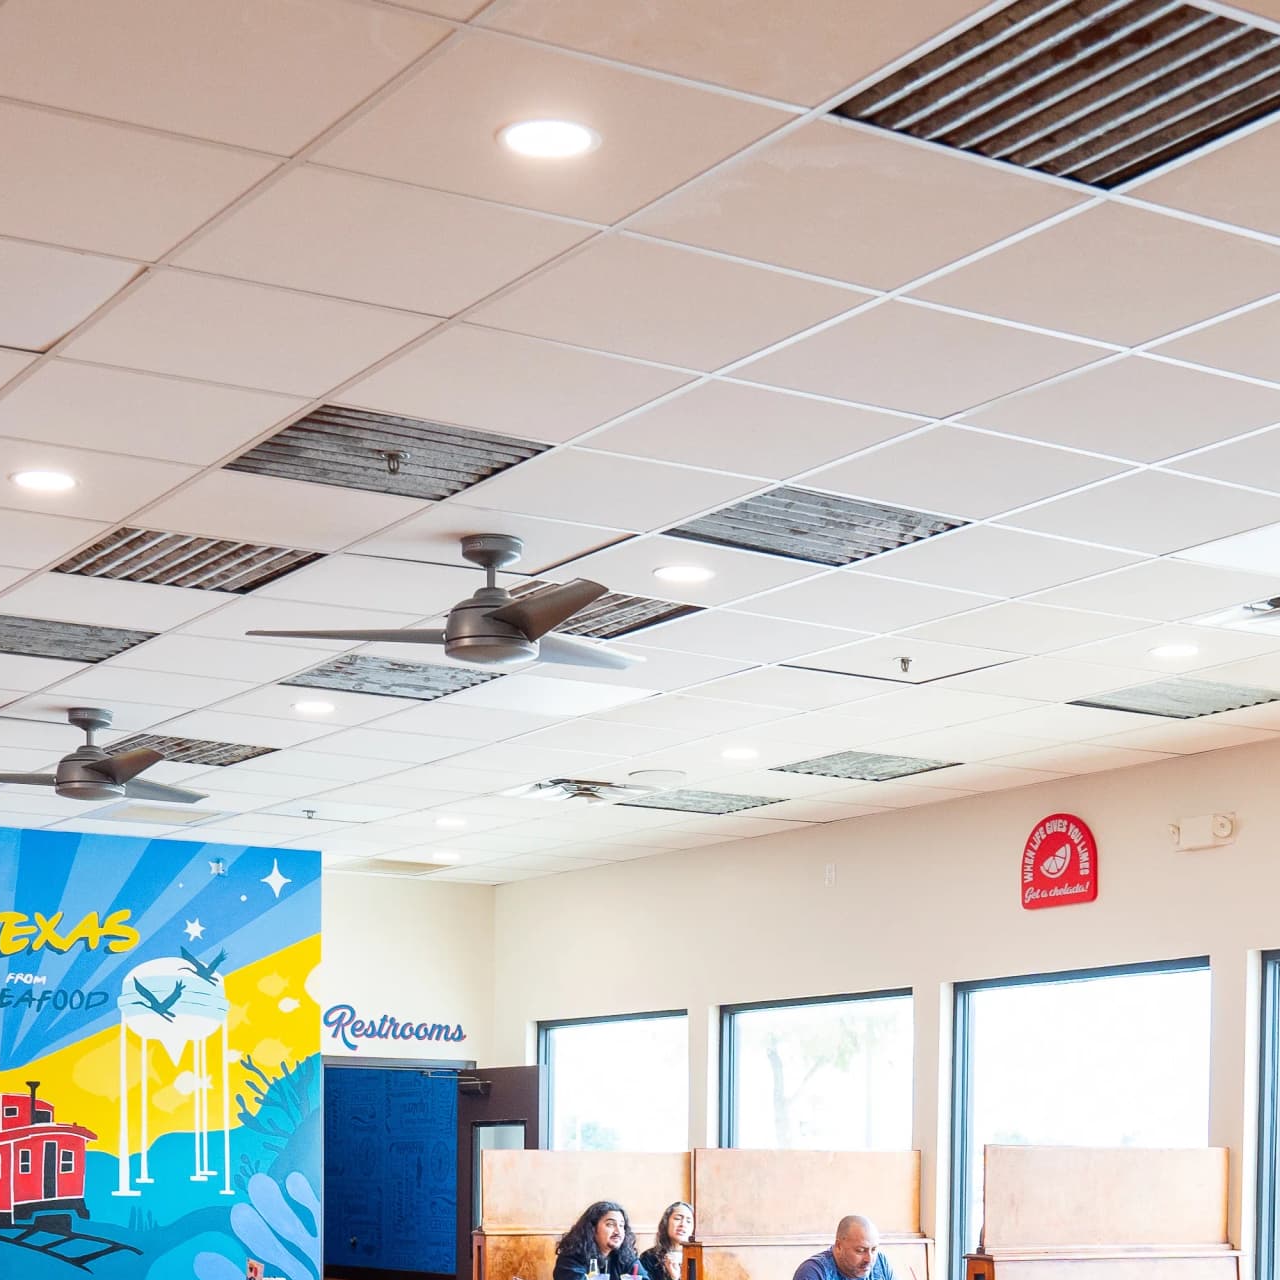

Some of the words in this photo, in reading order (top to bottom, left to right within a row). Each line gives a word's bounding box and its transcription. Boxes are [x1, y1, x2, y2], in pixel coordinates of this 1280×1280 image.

[1024, 850, 1036, 883] WHEN
[1031, 828, 1046, 850] LIFE
[1045, 819, 1068, 834] GIVES
[1068, 823, 1083, 843] YOU
[1025, 886, 1039, 903] Get
[5, 972, 47, 985] FROM
[323, 1004, 466, 1051] Restrooms
